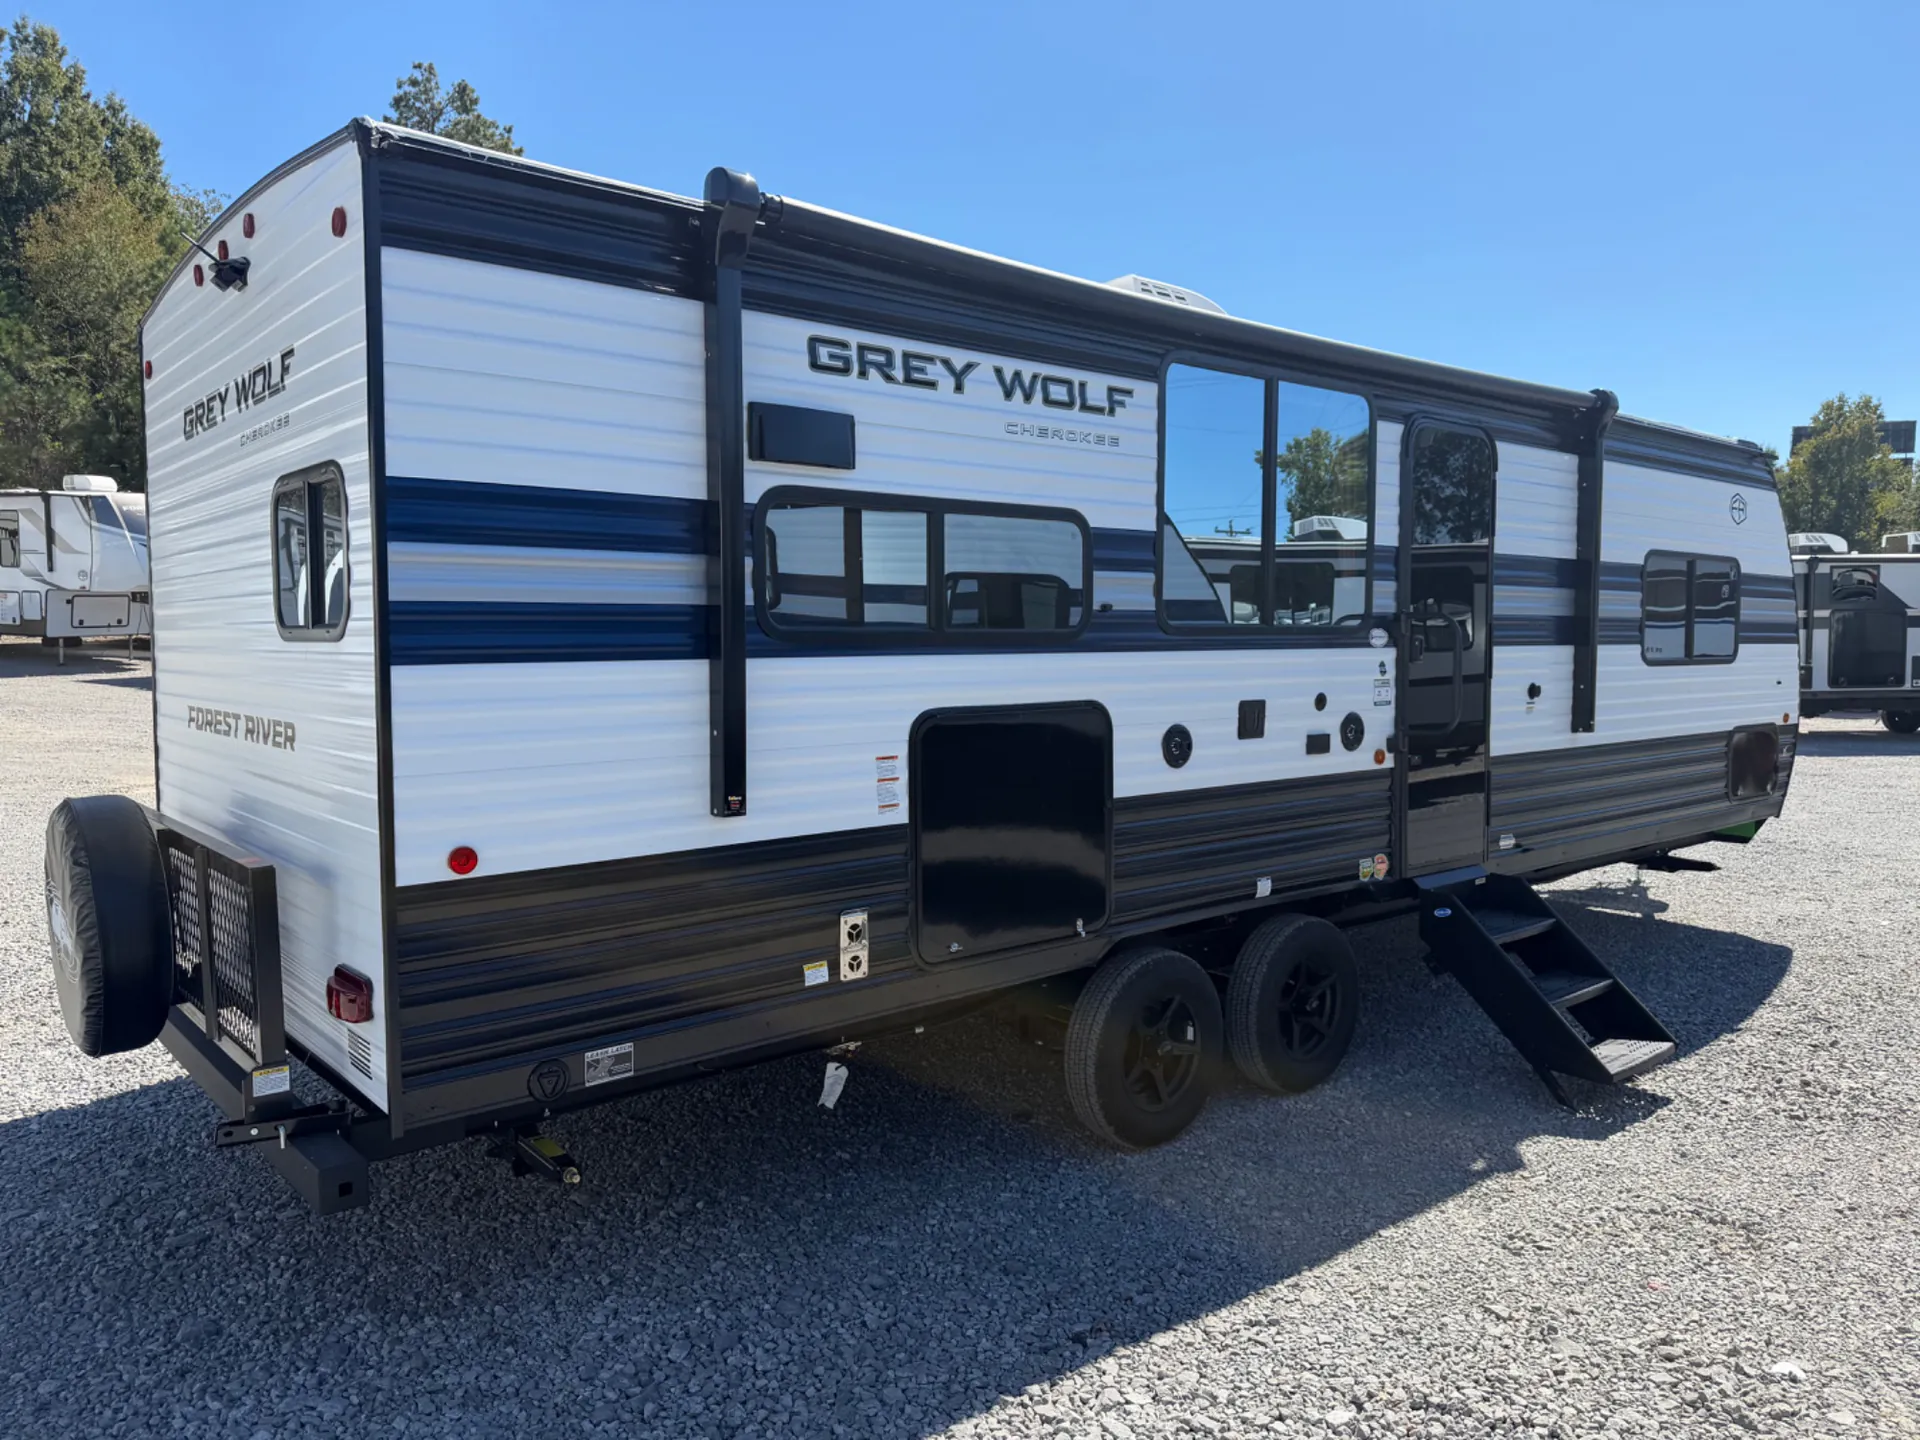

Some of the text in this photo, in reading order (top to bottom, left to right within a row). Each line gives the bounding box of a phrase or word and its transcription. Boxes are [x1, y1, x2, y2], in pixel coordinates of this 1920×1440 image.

[183, 344, 295, 442] GREY WOLF
[807, 334, 1134, 417] GREY WOLF
[240, 412, 290, 448] CHEROKEE
[1004, 421, 1120, 447] CHEROKEE
[187, 704, 296, 752] FOREST RIVER
